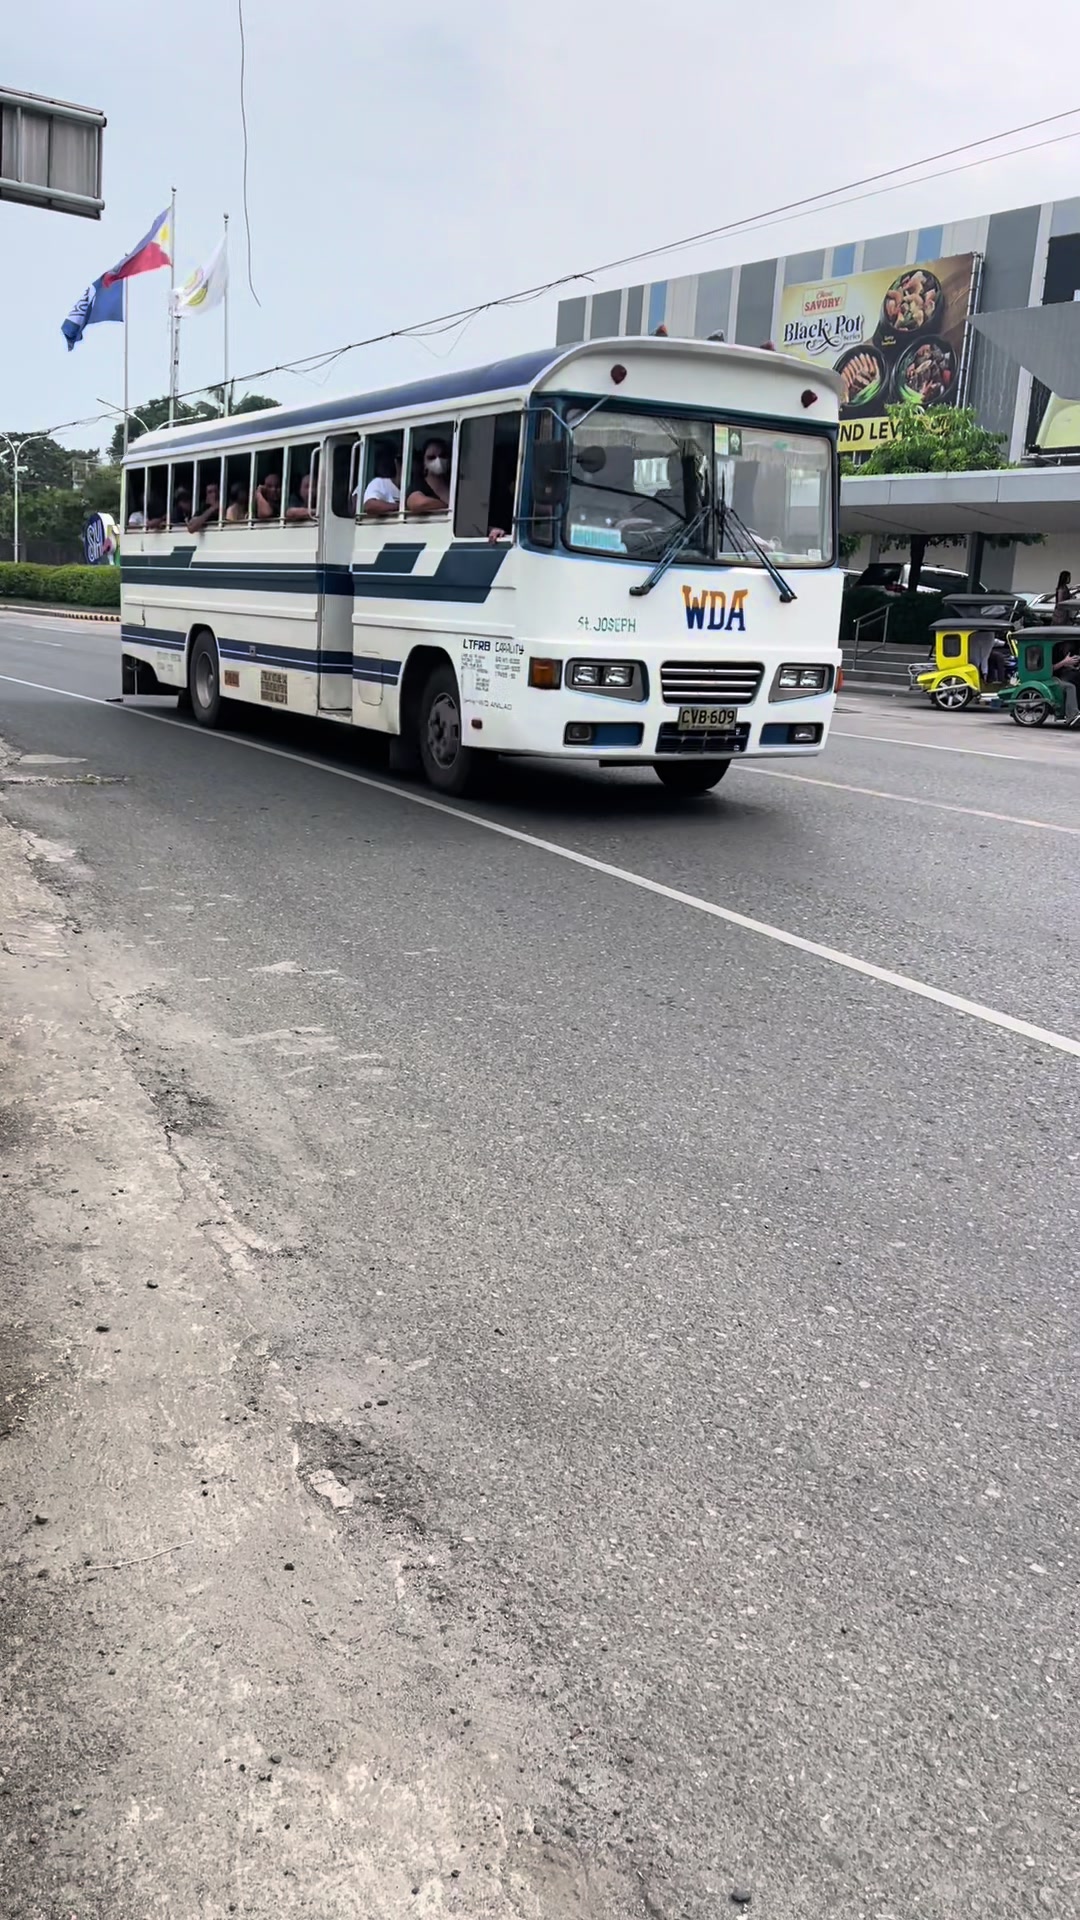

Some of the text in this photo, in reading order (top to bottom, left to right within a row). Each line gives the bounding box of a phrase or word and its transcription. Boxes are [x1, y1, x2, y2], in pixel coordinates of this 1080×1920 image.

[804, 297, 842, 312] SAVORY
[784, 315, 861, 348] Black Pot
[839, 424, 865, 443] ND
[682, 585, 749, 632] WDA
[593, 617, 637, 632] JOSEPH
[462, 639, 491, 652] LTFRB
